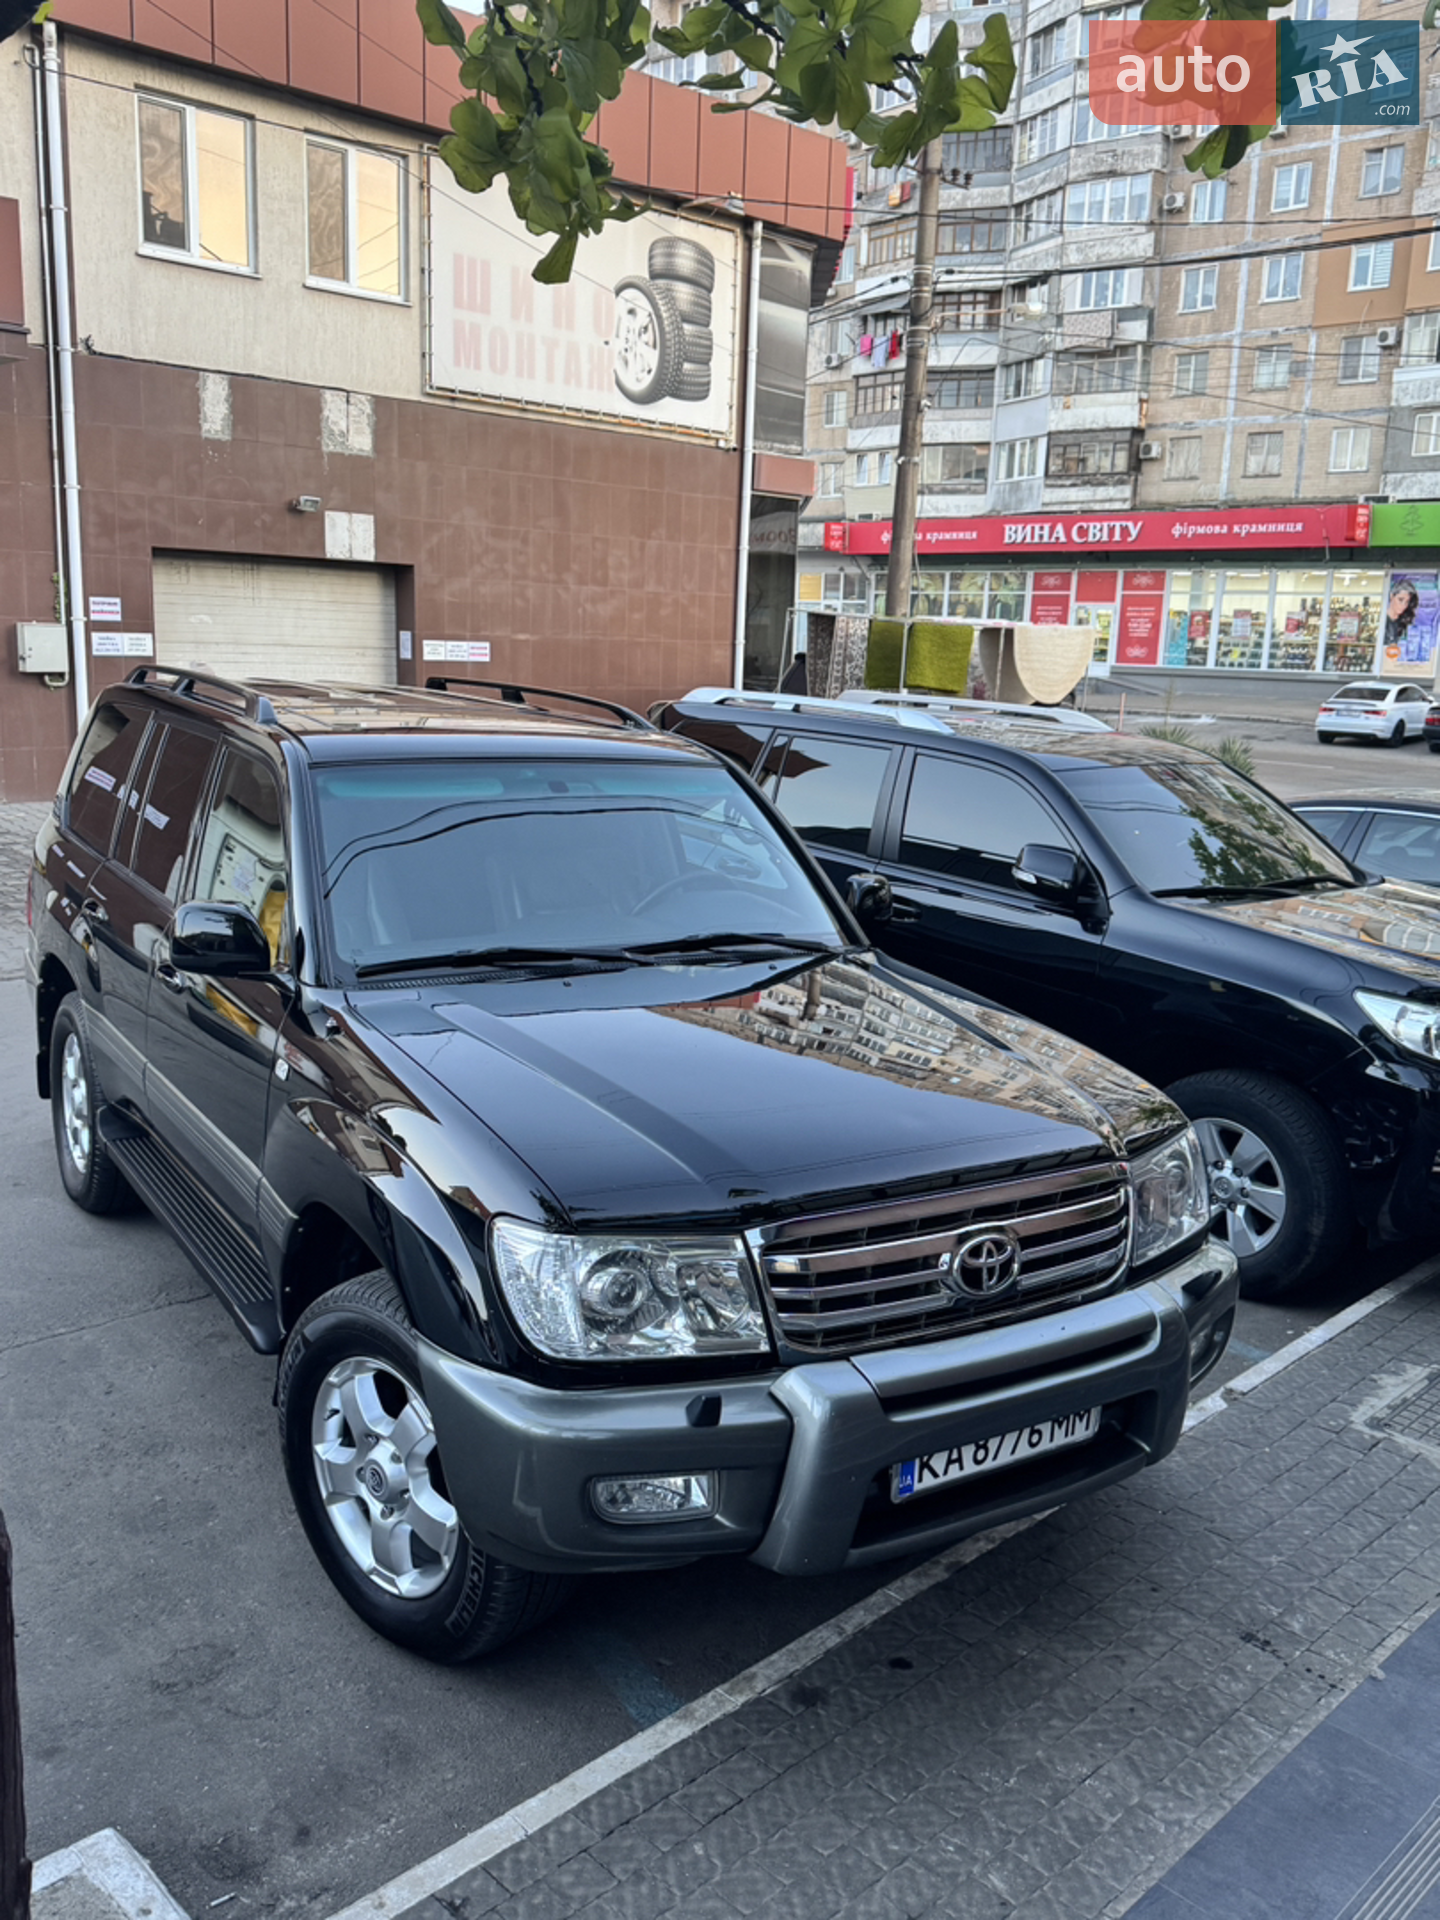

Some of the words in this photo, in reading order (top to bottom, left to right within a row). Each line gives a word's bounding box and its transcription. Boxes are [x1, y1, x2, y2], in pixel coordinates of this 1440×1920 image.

[453, 318, 615, 393] МОНТАЖ
[925, 530, 978, 545] крамниця
[1003, 522, 1067, 544] ВИНА
[1071, 520, 1144, 544] СВІТУ
[1171, 522, 1228, 540] фірмова
[1232, 522, 1304, 538] крамниця
[917, 1446, 964, 1483] KA
[1050, 1410, 1092, 1443] MM
